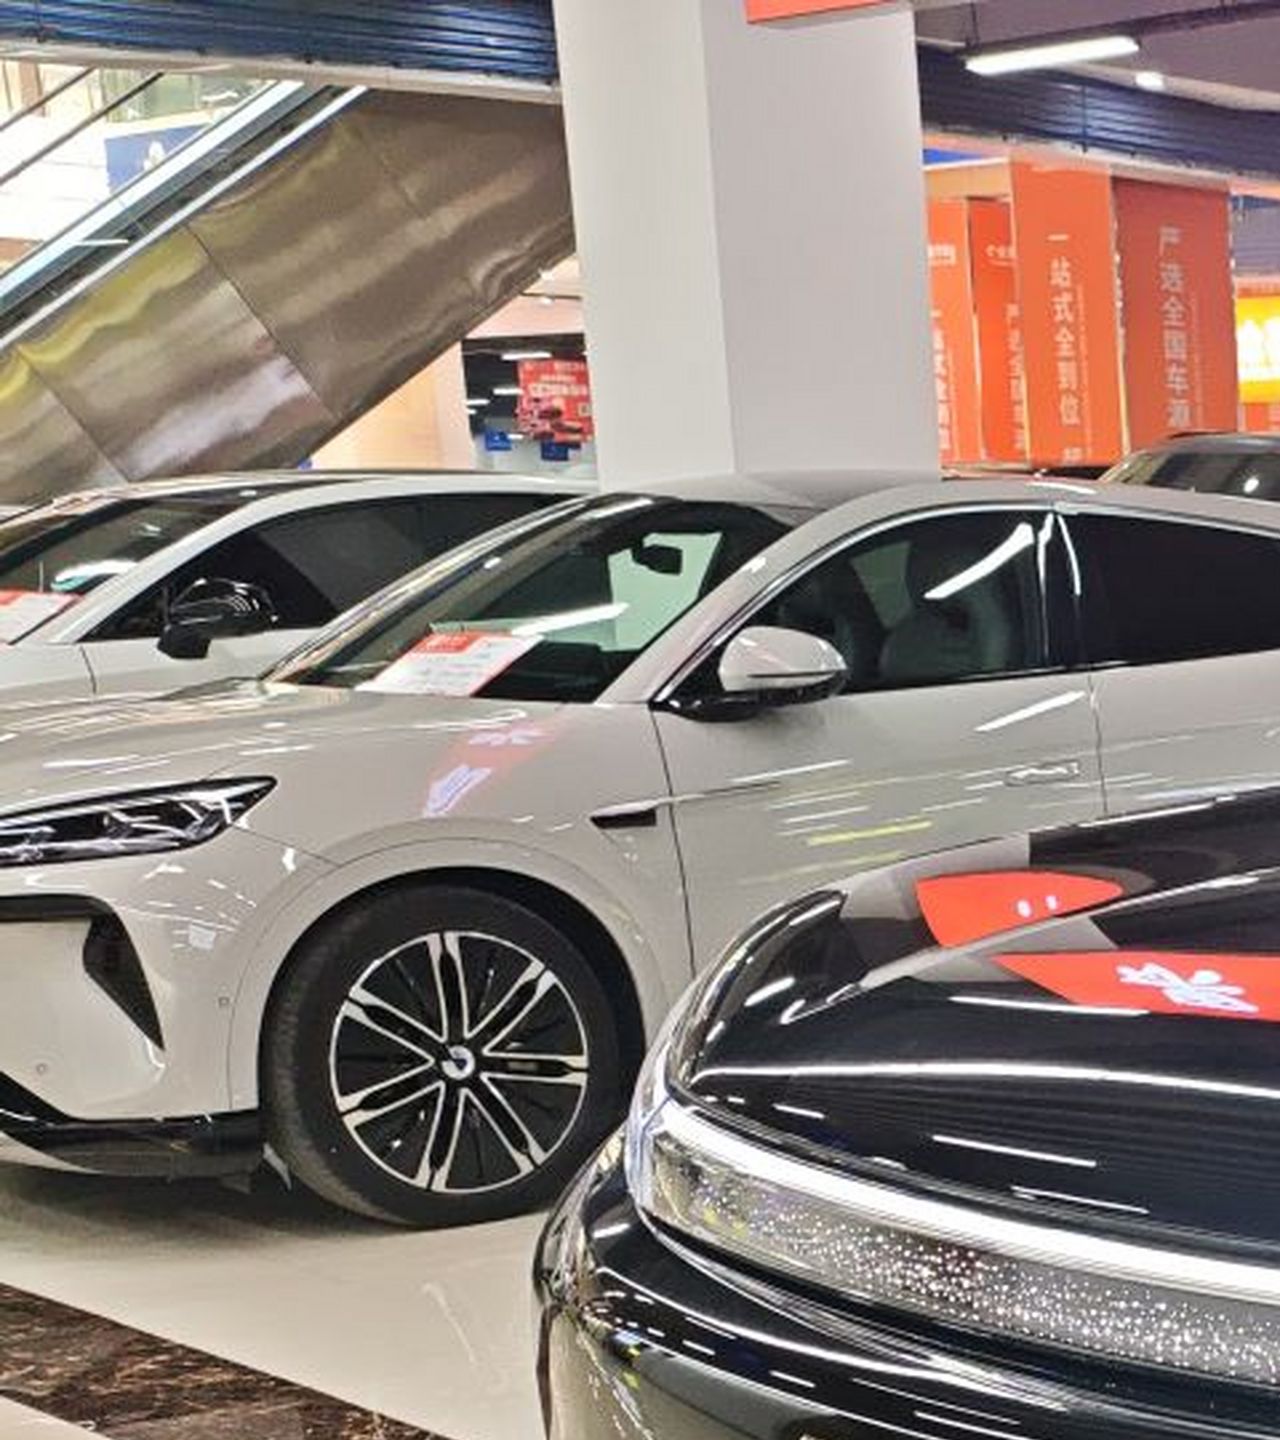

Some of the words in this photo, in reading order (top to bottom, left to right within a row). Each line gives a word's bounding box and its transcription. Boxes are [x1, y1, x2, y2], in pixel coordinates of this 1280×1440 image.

[1158, 225, 1191, 429] 严选全国车源
